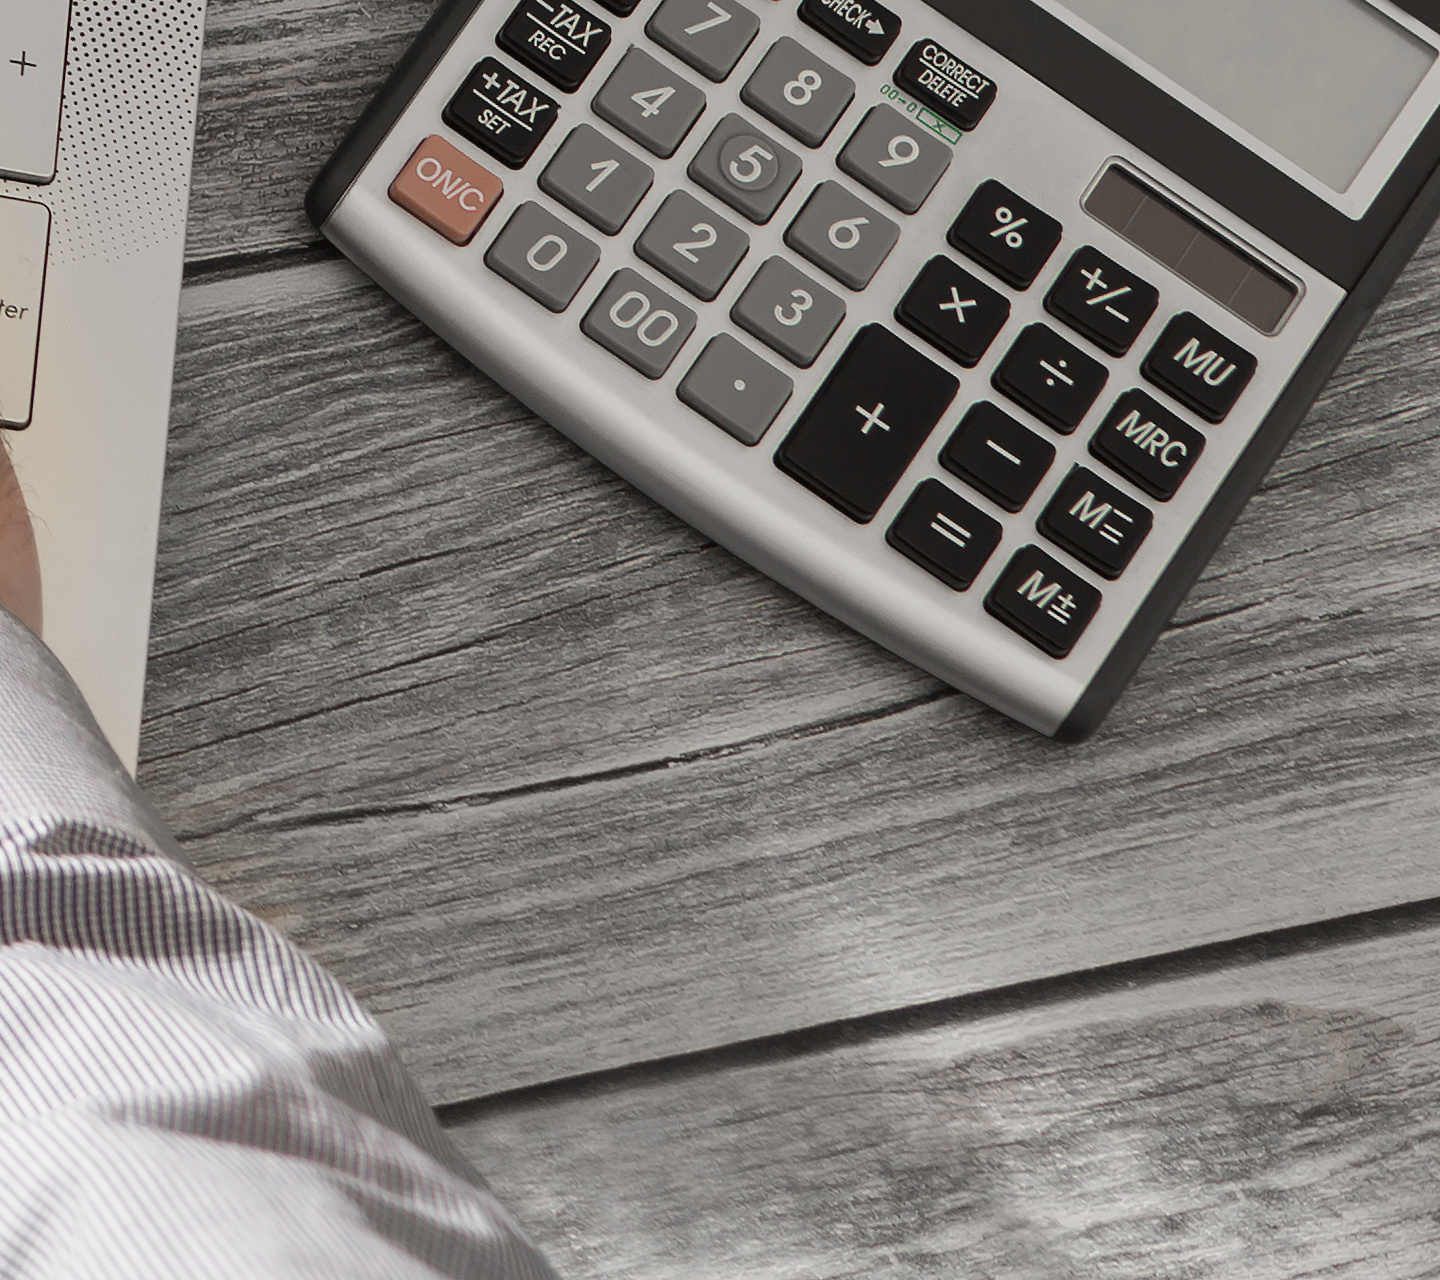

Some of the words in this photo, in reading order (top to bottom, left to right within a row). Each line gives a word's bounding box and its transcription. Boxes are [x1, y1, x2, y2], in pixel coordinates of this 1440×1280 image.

[684, 2, 731, 34] 7
[528, 30, 566, 59] REC
[922, 44, 990, 94] CORRECT
[482, 72, 550, 124] +TAX
[631, 87, 675, 117] 4
[784, 71, 821, 105] 8
[918, 69, 968, 107] DELETE
[478, 110, 511, 133] SET
[730, 145, 773, 182] 5
[879, 136, 919, 167] 9
[417, 158, 483, 210] ON/C
[589, 159, 614, 192] 1
[673, 223, 716, 262] 2
[829, 218, 869, 248] 6
[527, 235, 567, 271] 0
[774, 290, 812, 325] 3
[1081, 269, 1131, 322] +/-
[610, 292, 678, 346] 00
[1174, 338, 1236, 385] MU
[1116, 410, 1186, 466] MRC
